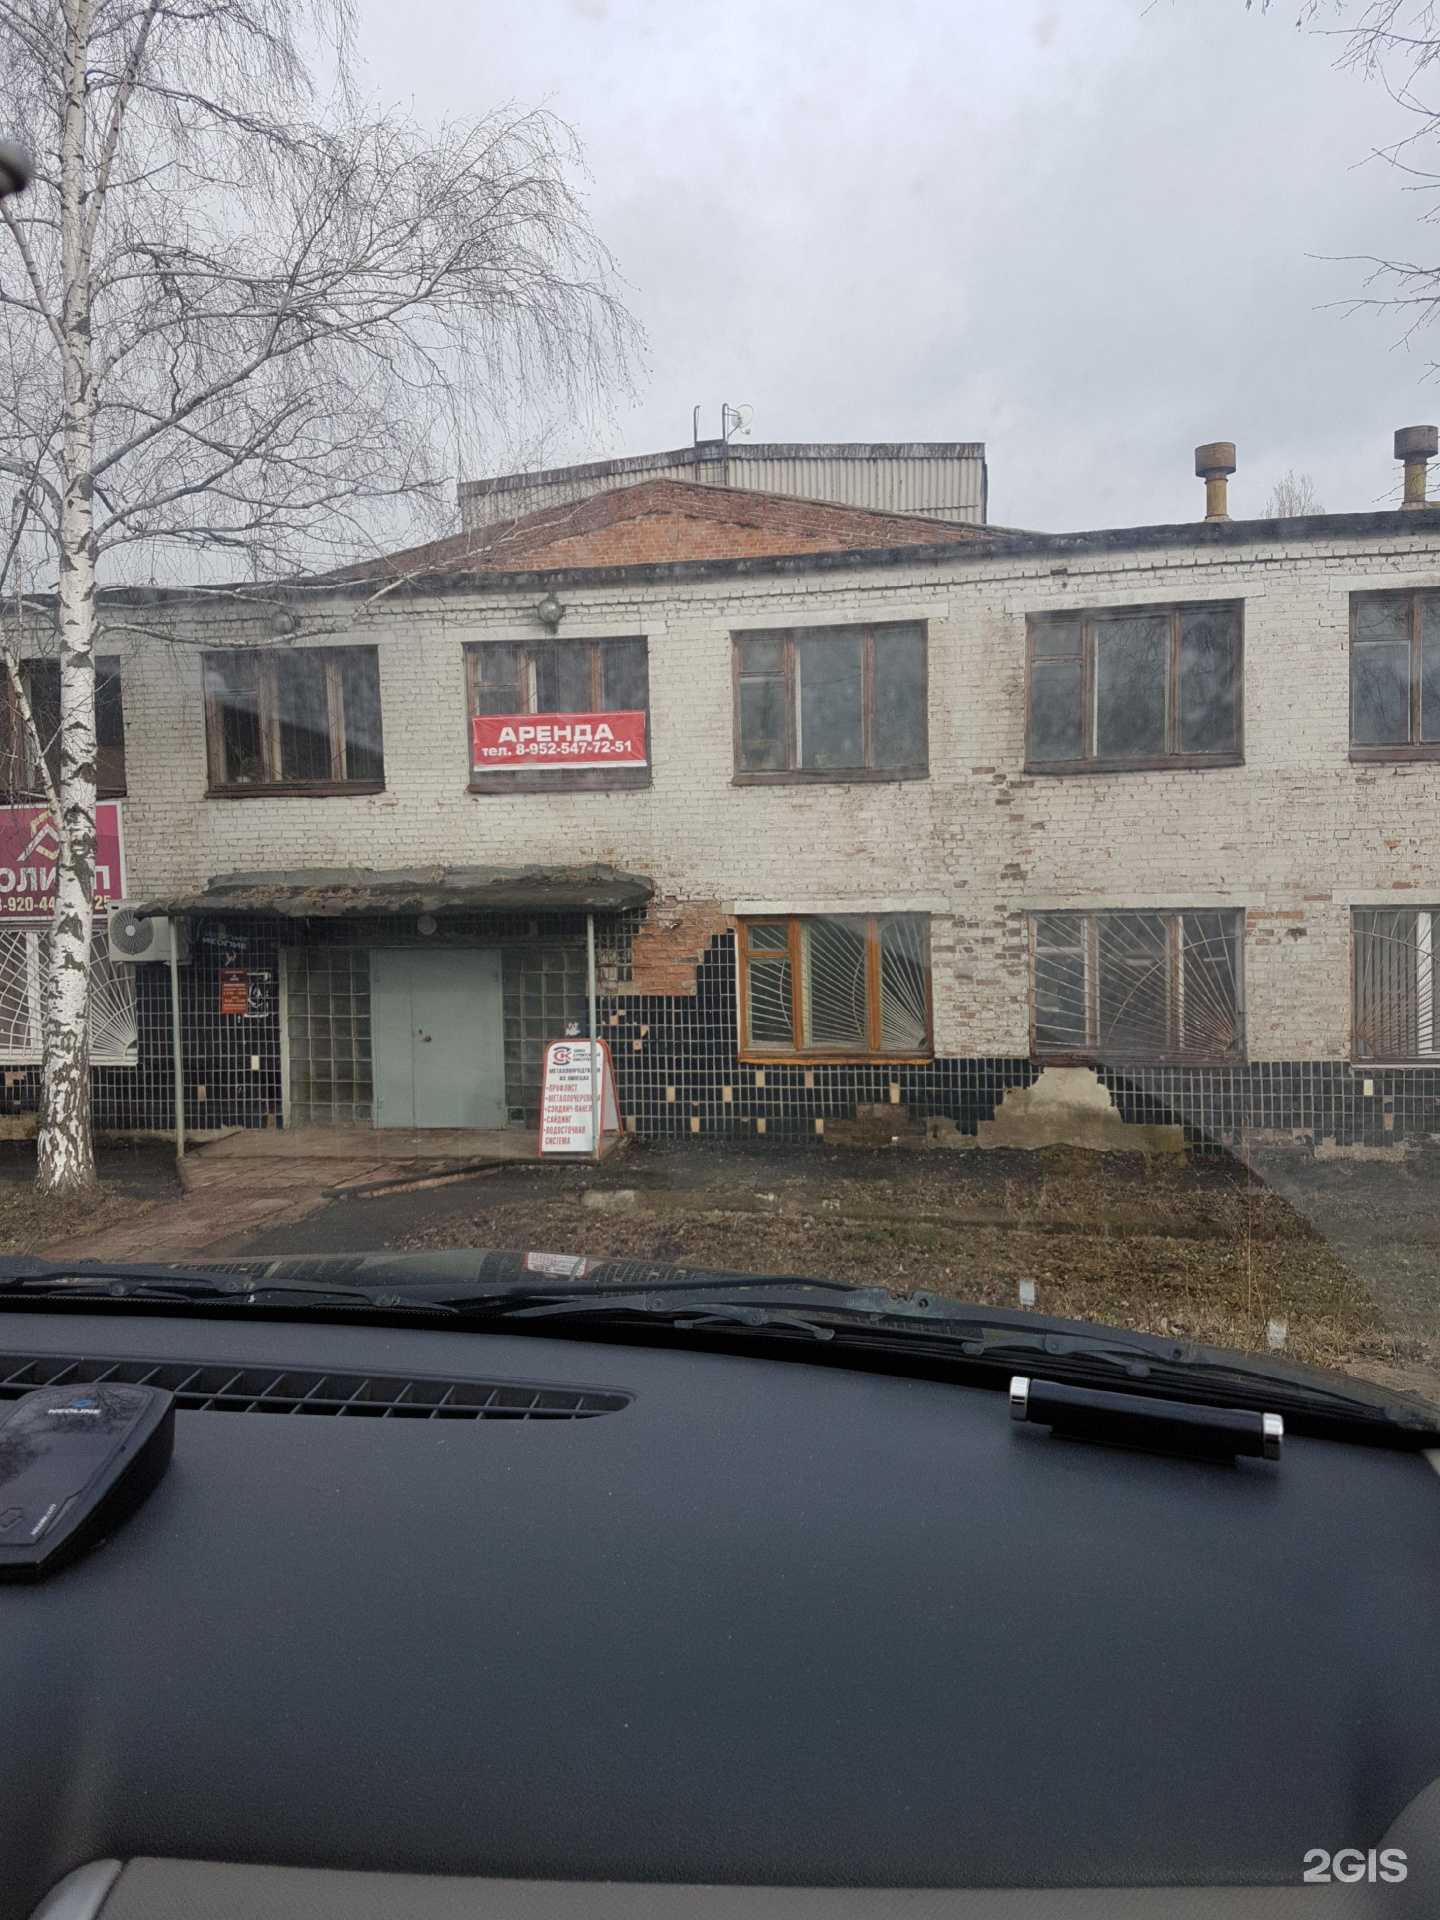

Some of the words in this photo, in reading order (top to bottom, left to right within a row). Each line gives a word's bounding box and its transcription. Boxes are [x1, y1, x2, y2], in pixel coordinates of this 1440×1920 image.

[499, 723, 614, 743] АРЕНДА
[482, 746, 512, 757] тел.
[515, 740, 632, 756] 8-952-547-72-51
